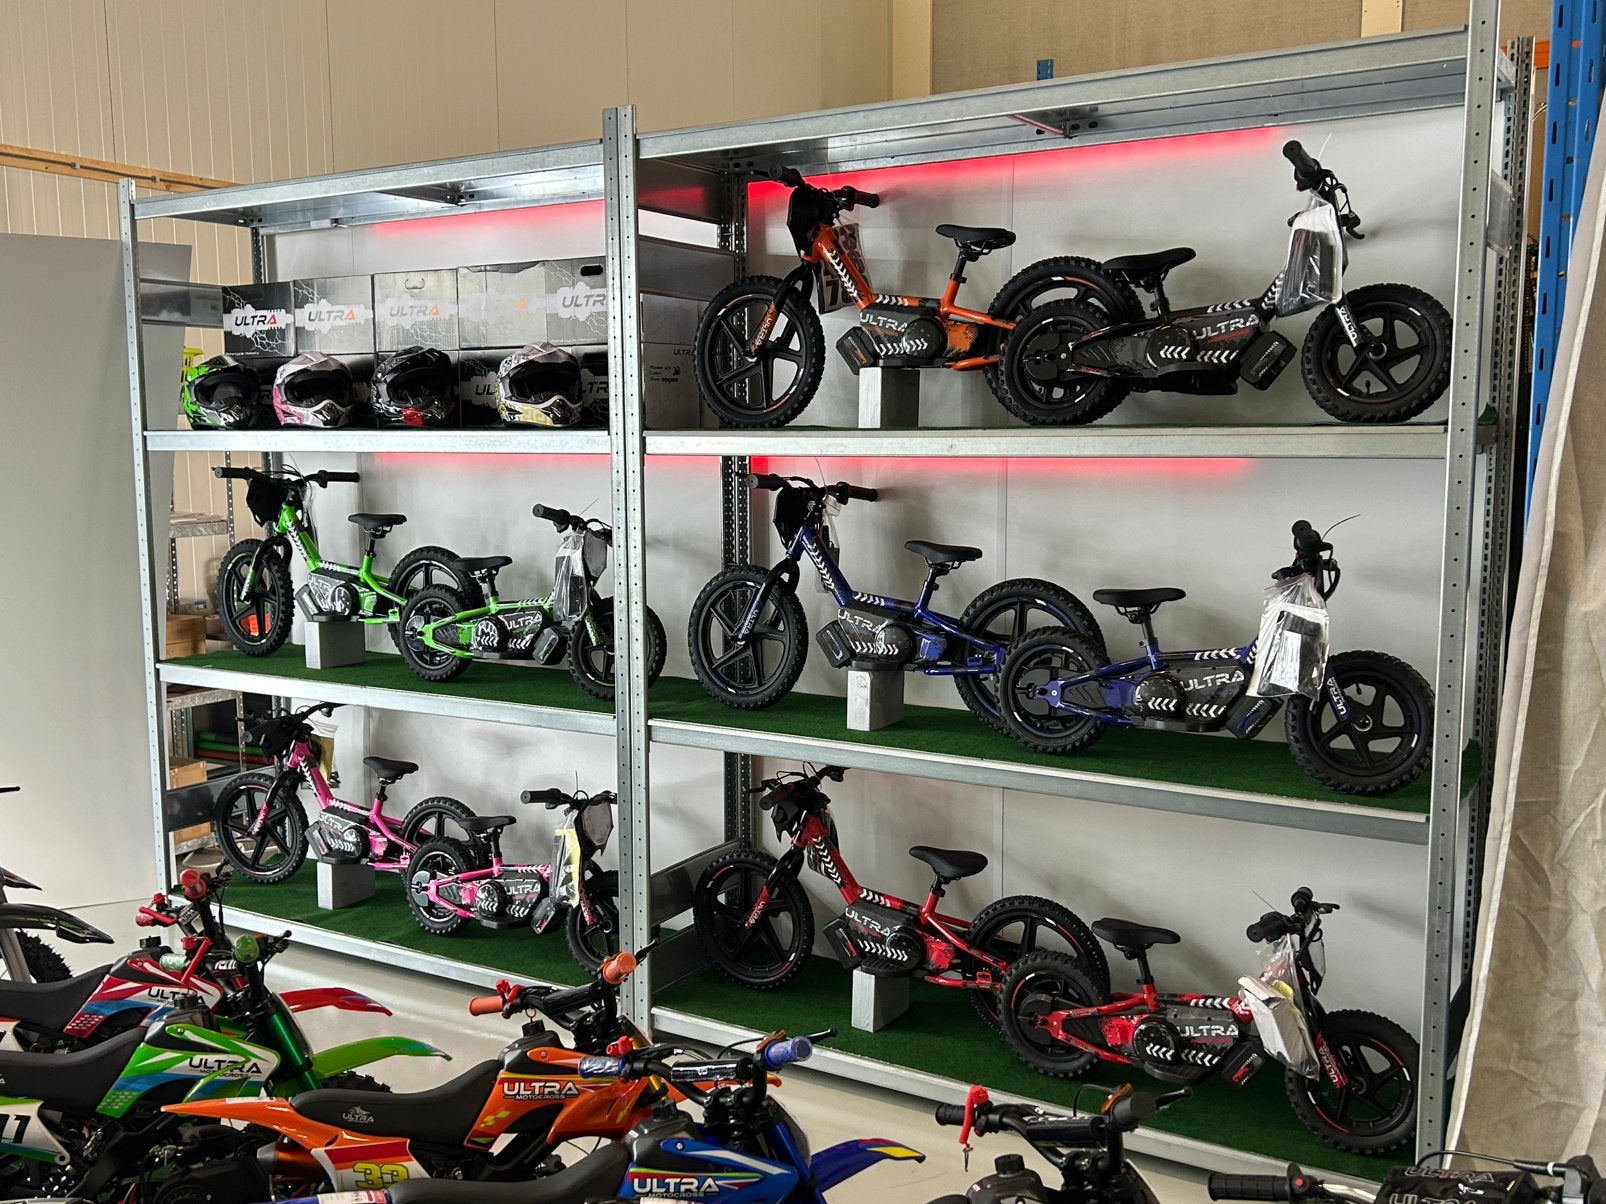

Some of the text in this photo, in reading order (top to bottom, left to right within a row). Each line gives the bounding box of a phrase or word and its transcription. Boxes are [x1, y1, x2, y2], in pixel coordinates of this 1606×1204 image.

[561, 293, 608, 308] ULTR
[307, 309, 357, 322] ULTRA
[389, 303, 442, 318] ULTRA
[234, 313, 279, 327] ULTRA
[860, 311, 909, 333] ULTRA
[1192, 313, 1260, 339] ULTRA
[1339, 305, 1358, 341] ULTRA
[505, 611, 543, 630] ULTRA
[1180, 670, 1245, 691] ULTRA
[1326, 677, 1347, 715] ULTRA
[505, 883, 541, 895] ULTRA
[845, 907, 891, 937] ULTRA
[1176, 1024, 1239, 1037] ULTRA
[189, 1057, 262, 1074] ULTRA
[503, 1081, 580, 1096] ULTRA
[342, 1112, 375, 1123] ULTRA
[633, 1176, 720, 1194] ULTRA
